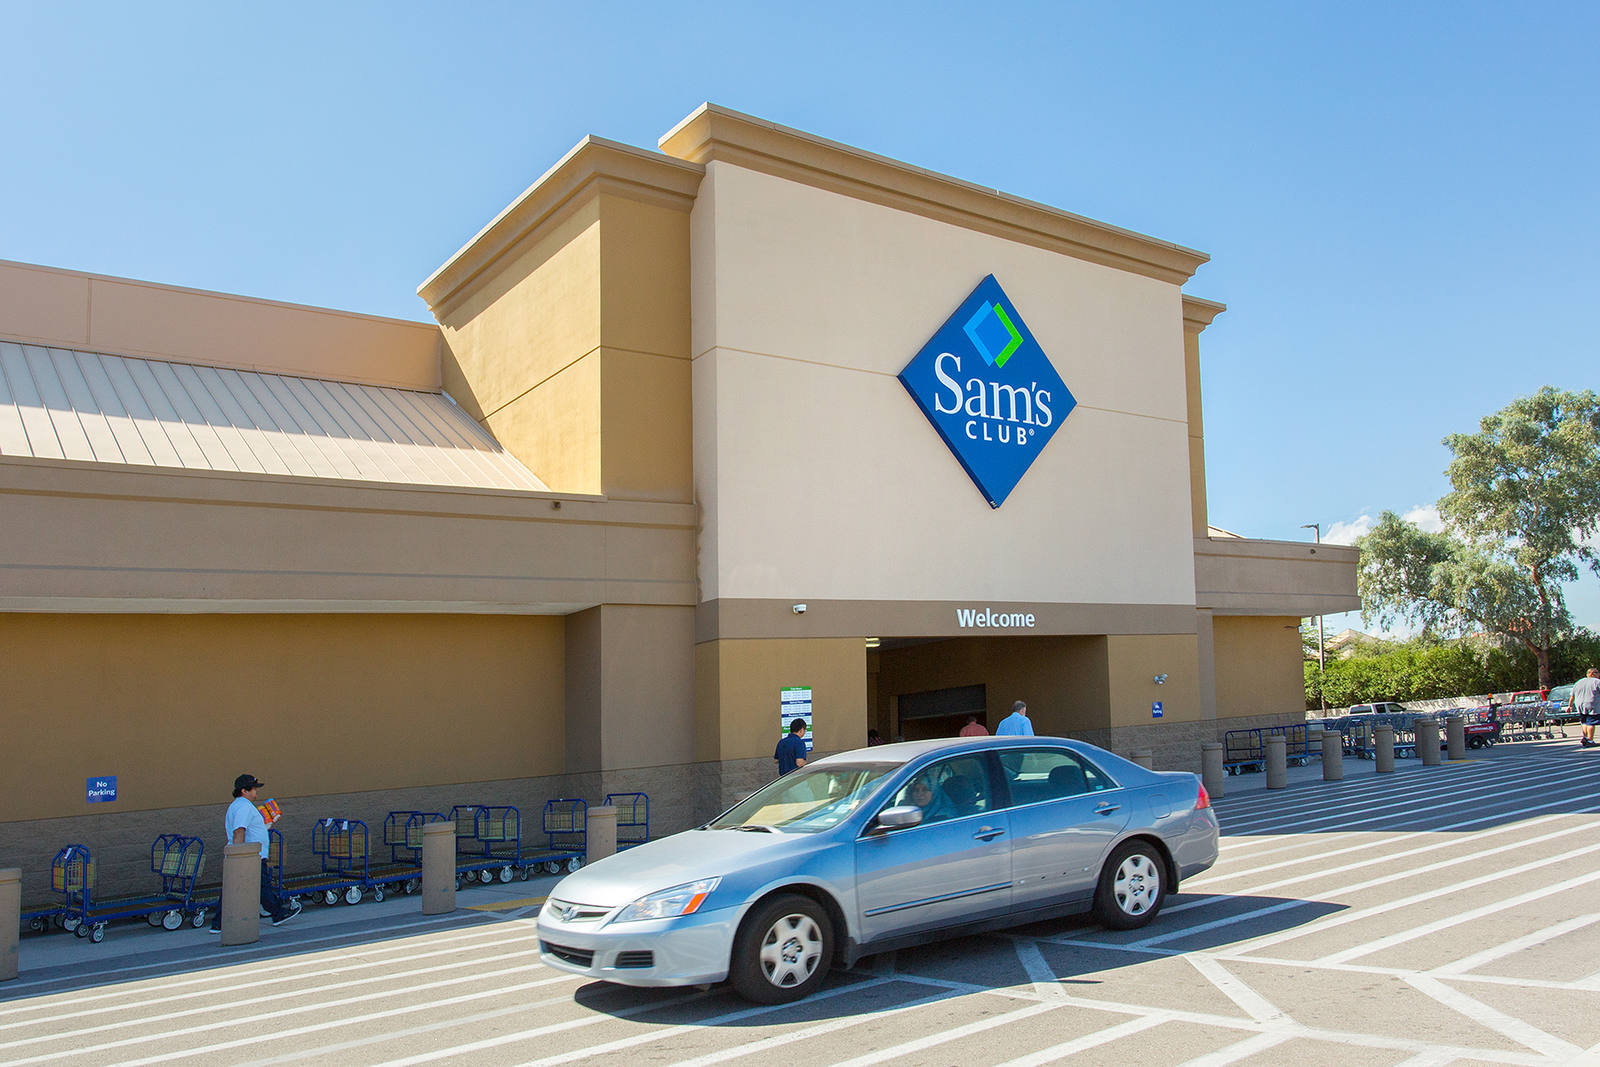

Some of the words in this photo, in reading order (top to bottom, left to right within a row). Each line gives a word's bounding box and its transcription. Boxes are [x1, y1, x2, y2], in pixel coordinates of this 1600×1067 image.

[934, 352, 1052, 427] Sam's
[965, 420, 1028, 445] CLUB
[956, 607, 1035, 628] Welcome
[88, 789, 115, 797] Parking
